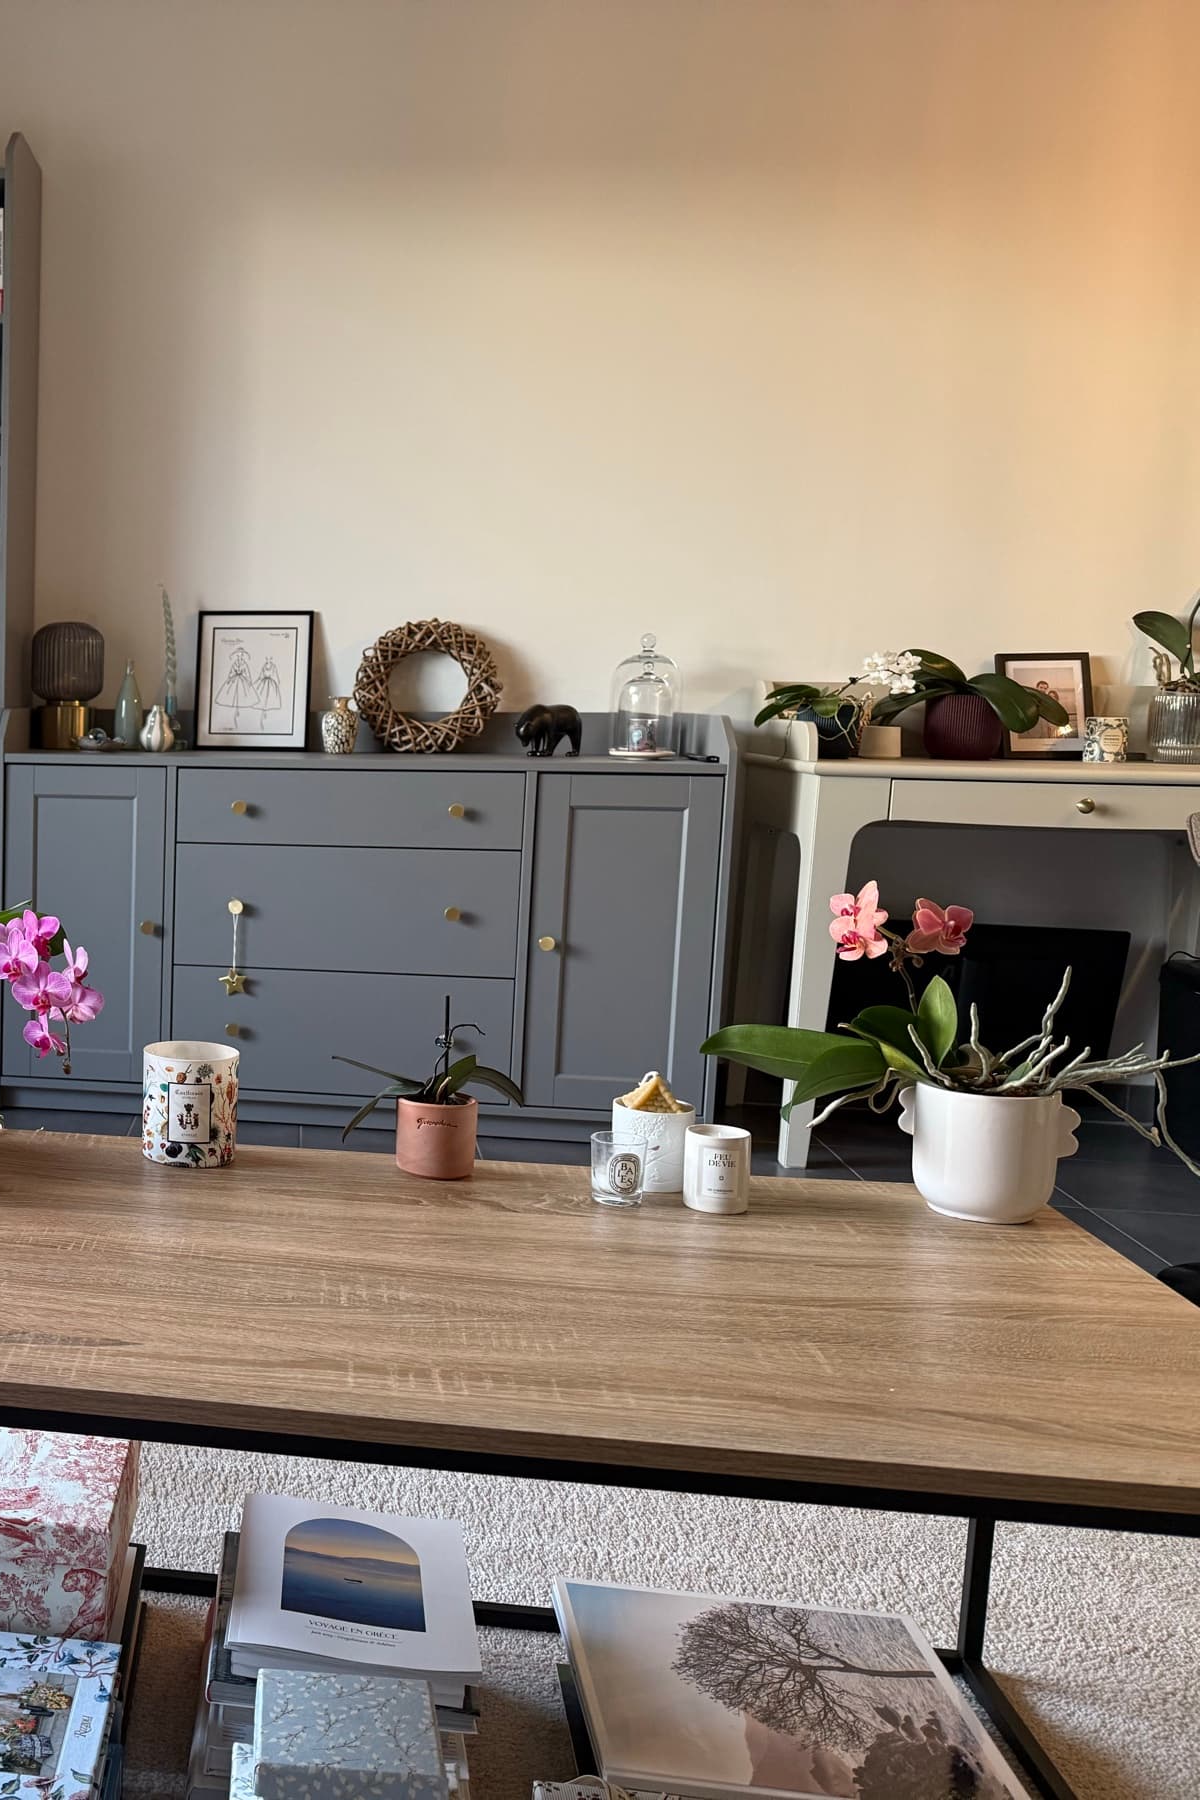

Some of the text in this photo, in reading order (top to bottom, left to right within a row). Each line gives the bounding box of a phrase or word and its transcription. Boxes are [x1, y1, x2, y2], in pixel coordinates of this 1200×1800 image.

[722, 1160, 736, 1168] VIE
[308, 1619, 348, 1632] VOYAGE
[350, 1627, 363, 1635] EN
